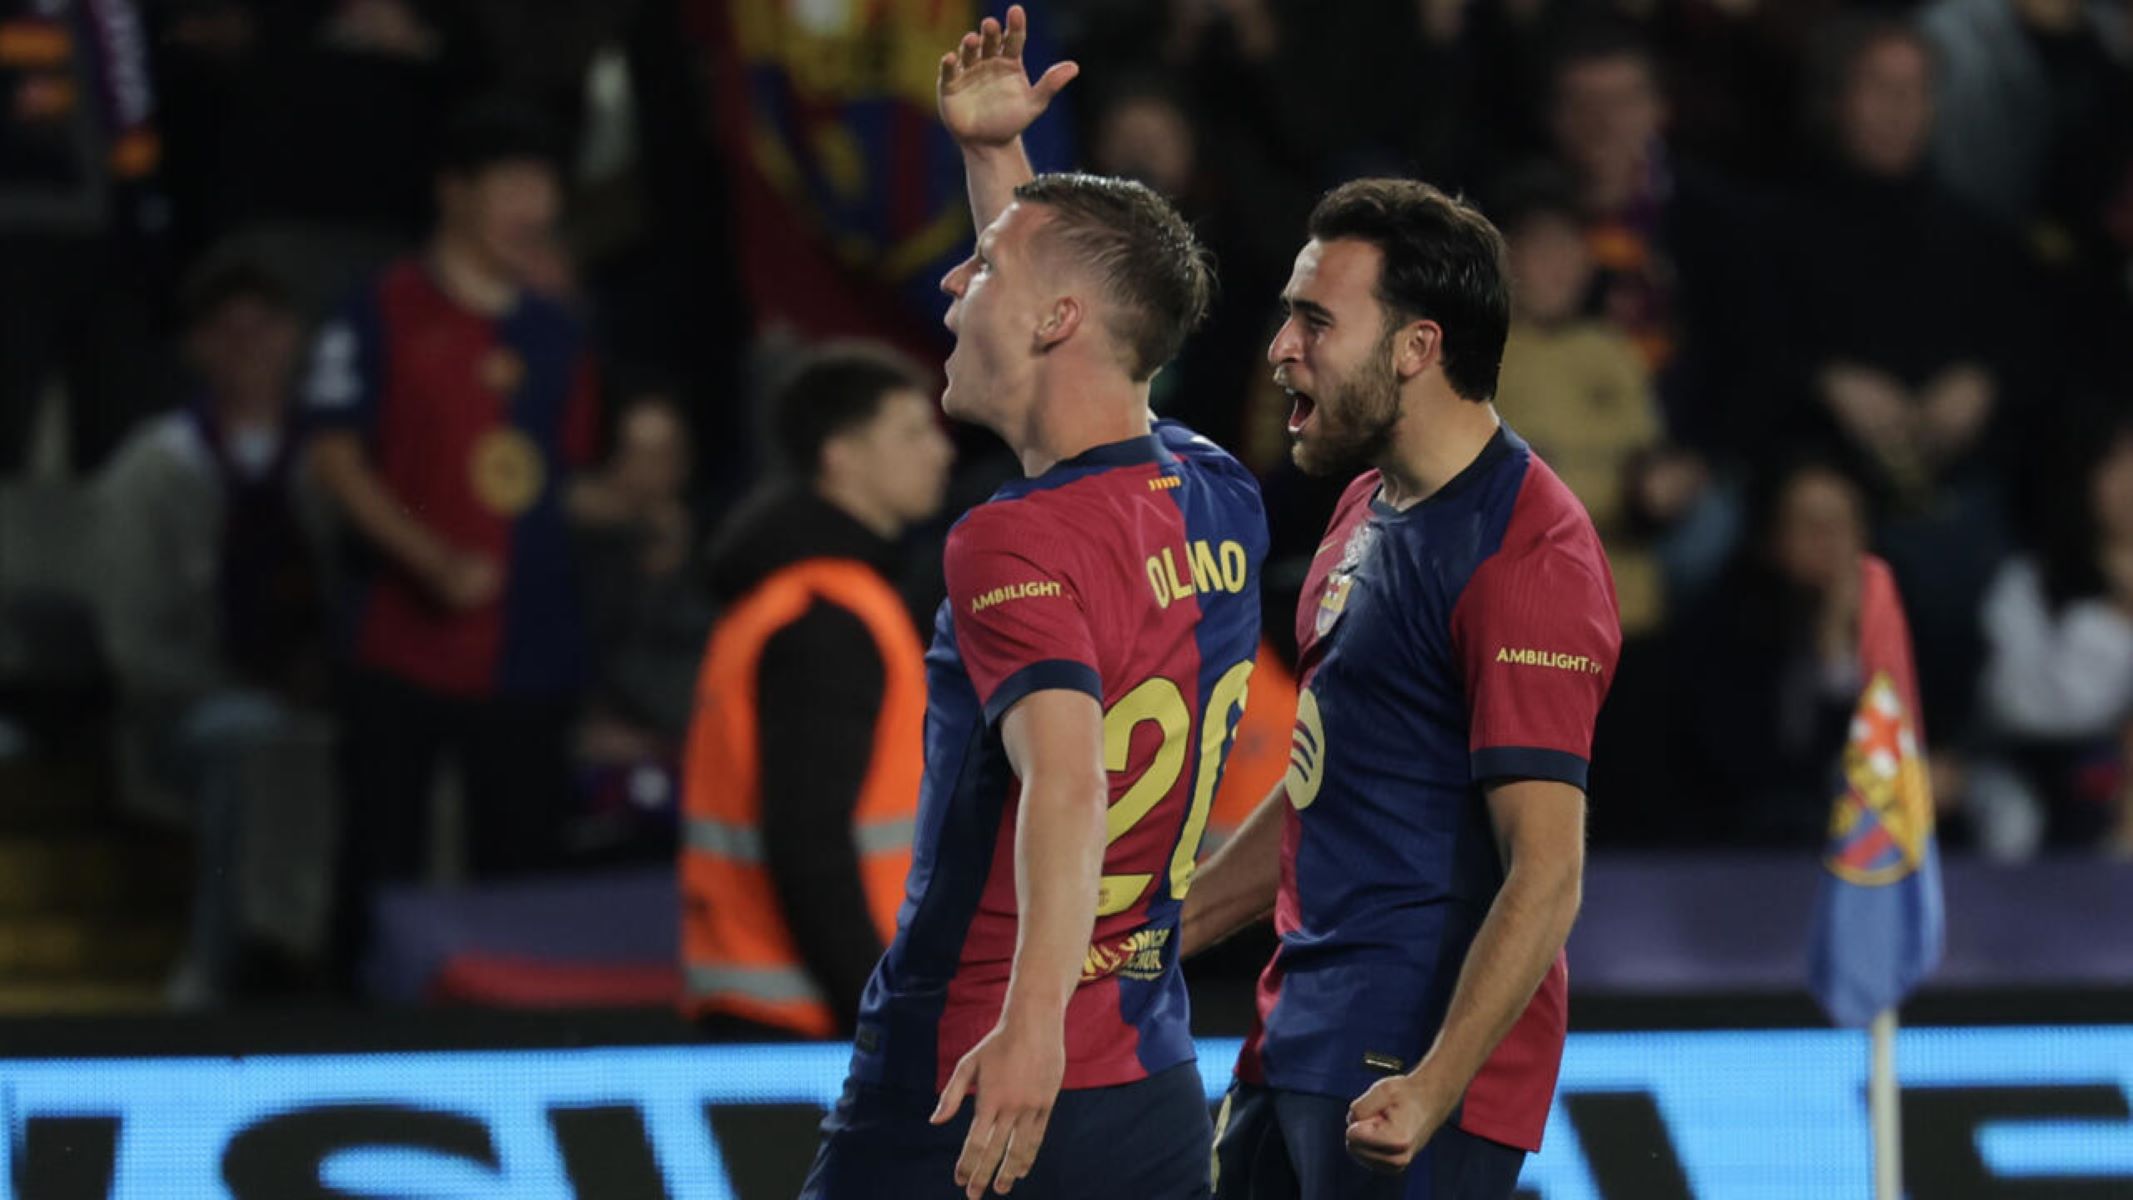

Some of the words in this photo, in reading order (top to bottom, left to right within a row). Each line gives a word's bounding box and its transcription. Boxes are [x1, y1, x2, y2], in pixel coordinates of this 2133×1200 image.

[1146, 540, 1246, 608] OLMO
[971, 581, 1061, 613] AMBILIGHT
[1496, 647, 1589, 672] AMBILIGHT
